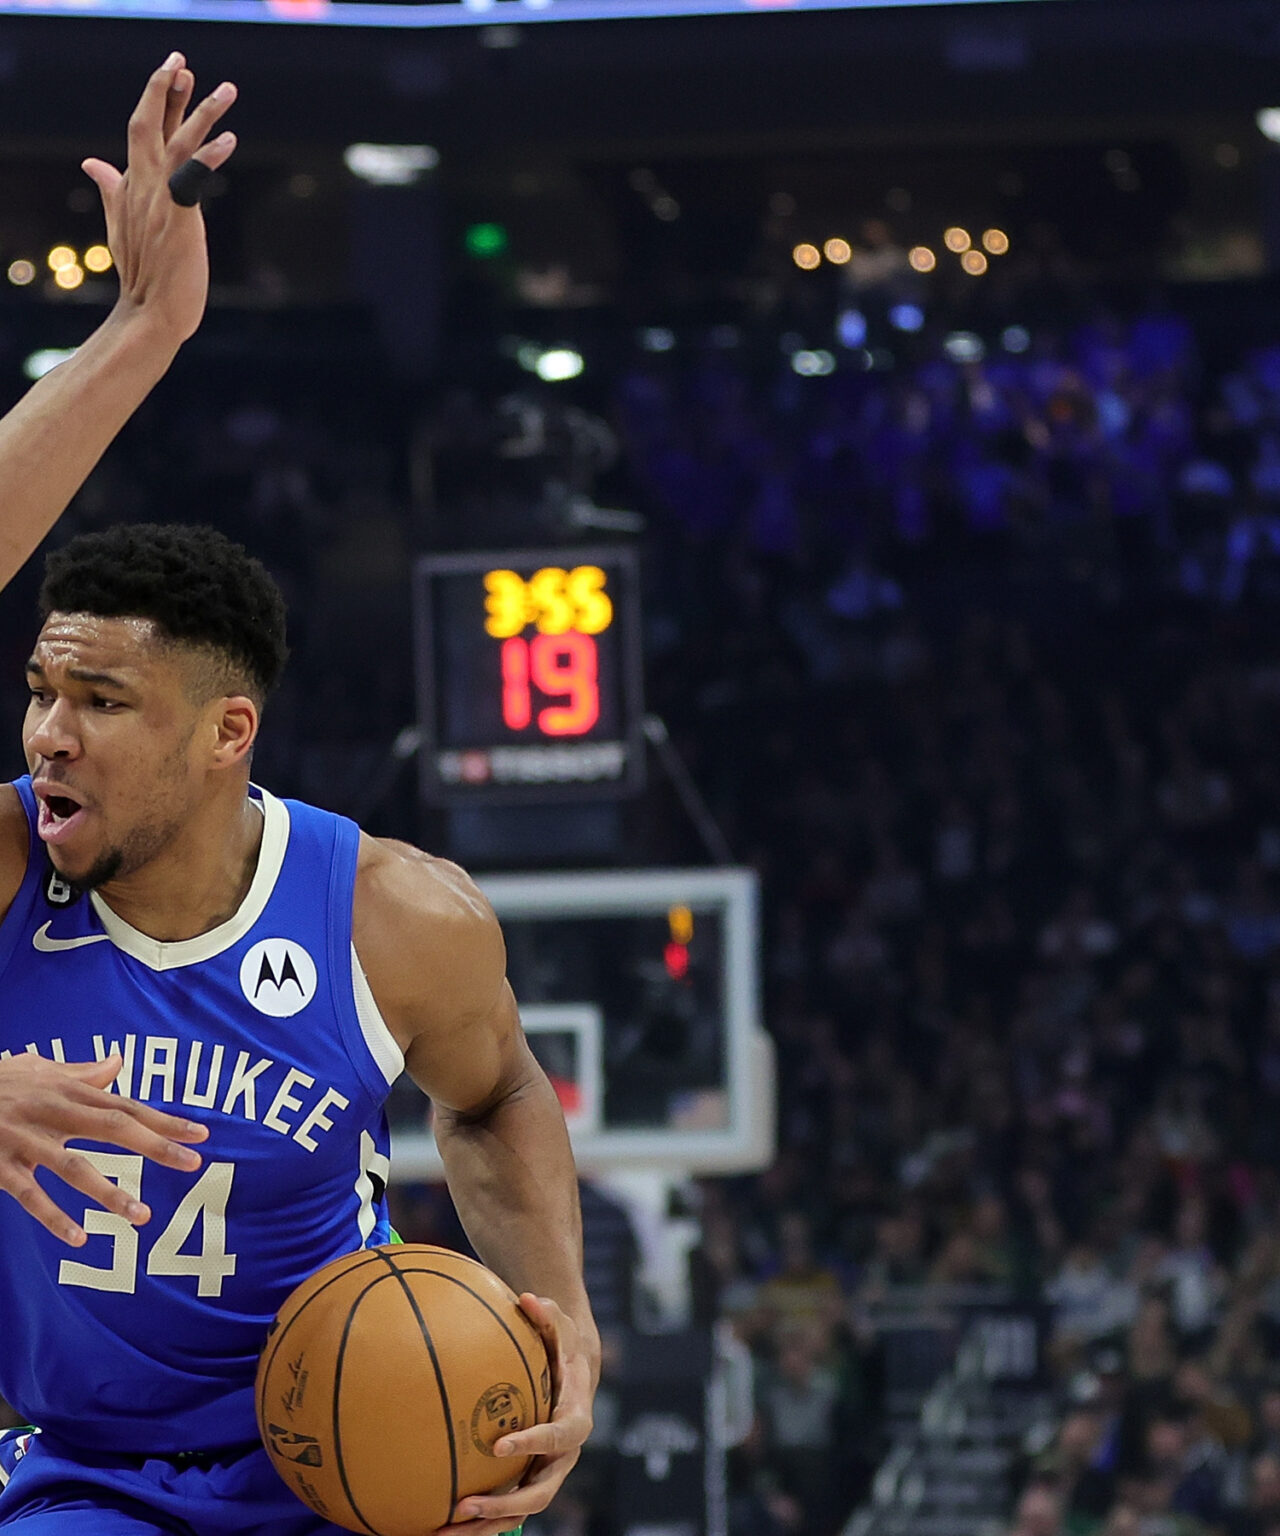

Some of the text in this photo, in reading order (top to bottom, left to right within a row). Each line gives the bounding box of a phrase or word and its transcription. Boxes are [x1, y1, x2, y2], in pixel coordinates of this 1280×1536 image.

[483, 566, 613, 638] 3:55
[501, 630, 599, 736] 19
[58, 1147, 237, 1298] 34
